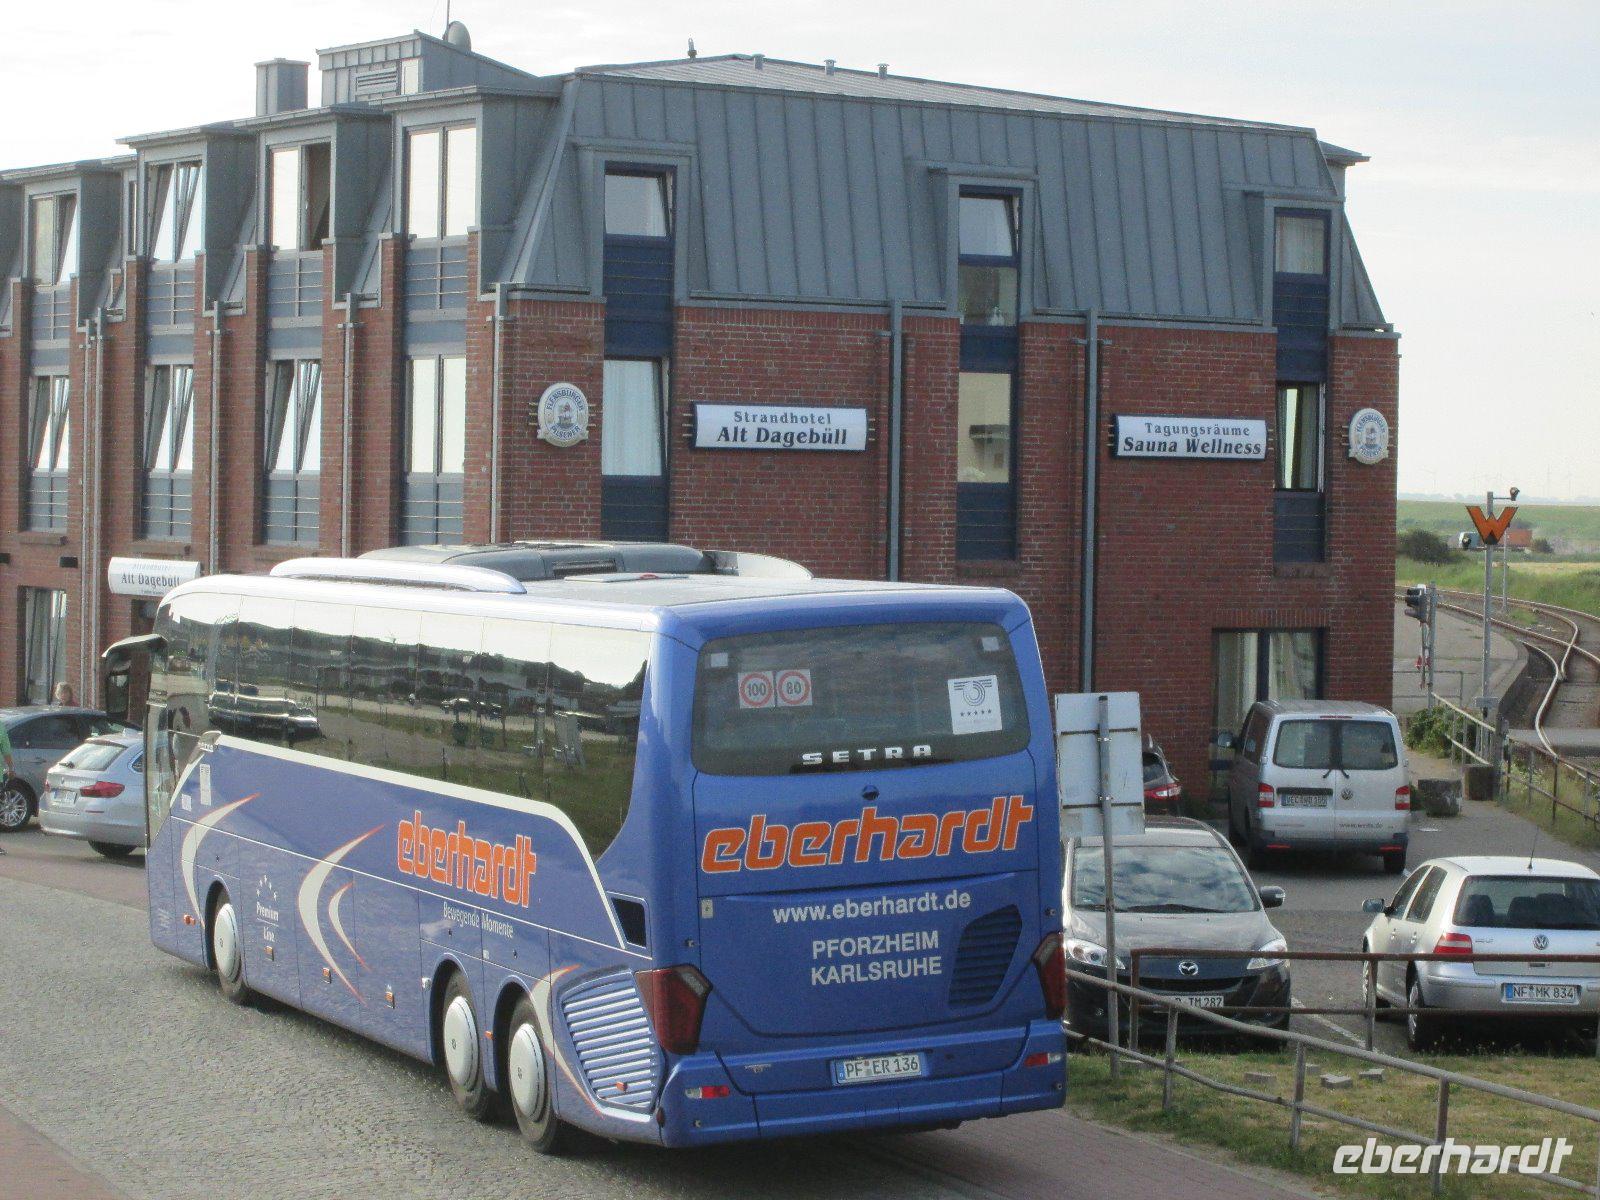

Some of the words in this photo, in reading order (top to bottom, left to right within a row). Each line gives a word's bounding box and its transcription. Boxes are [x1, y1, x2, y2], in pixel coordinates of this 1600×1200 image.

[546, 388, 585, 411] FLENSBURGER
[734, 411, 831, 425] Strandhotel
[550, 425, 581, 438] PILSENER
[716, 427, 748, 443] Alt
[756, 427, 848, 448] Dagebüll
[1145, 422, 1250, 437] Tagungsräume
[1123, 437, 1178, 453] Sauna
[1186, 438, 1262, 455] Wellness
[1465, 506, 1518, 545] W
[121, 573, 135, 585] Alt
[747, 683, 767, 697] 100
[786, 682, 801, 694] 80
[802, 745, 932, 765] SETRA
[701, 795, 1034, 874] eberhardt
[397, 810, 537, 908] eberhardt
[257, 901, 279, 922] Premium
[773, 889, 971, 924] www.eberhardt.de
[443, 901, 480, 928] Bewegende
[481, 912, 514, 939] Momente
[263, 926, 275, 943] Line
[812, 930, 939, 959] PFORZHEIM
[811, 956, 942, 985] KARLSRUHE
[1513, 988, 1527, 998] NF
[1536, 988, 1550, 998] MK
[1553, 989, 1574, 999] 834
[845, 1061, 862, 1077] PF
[873, 1059, 890, 1075] ER
[894, 1056, 918, 1072] 136
